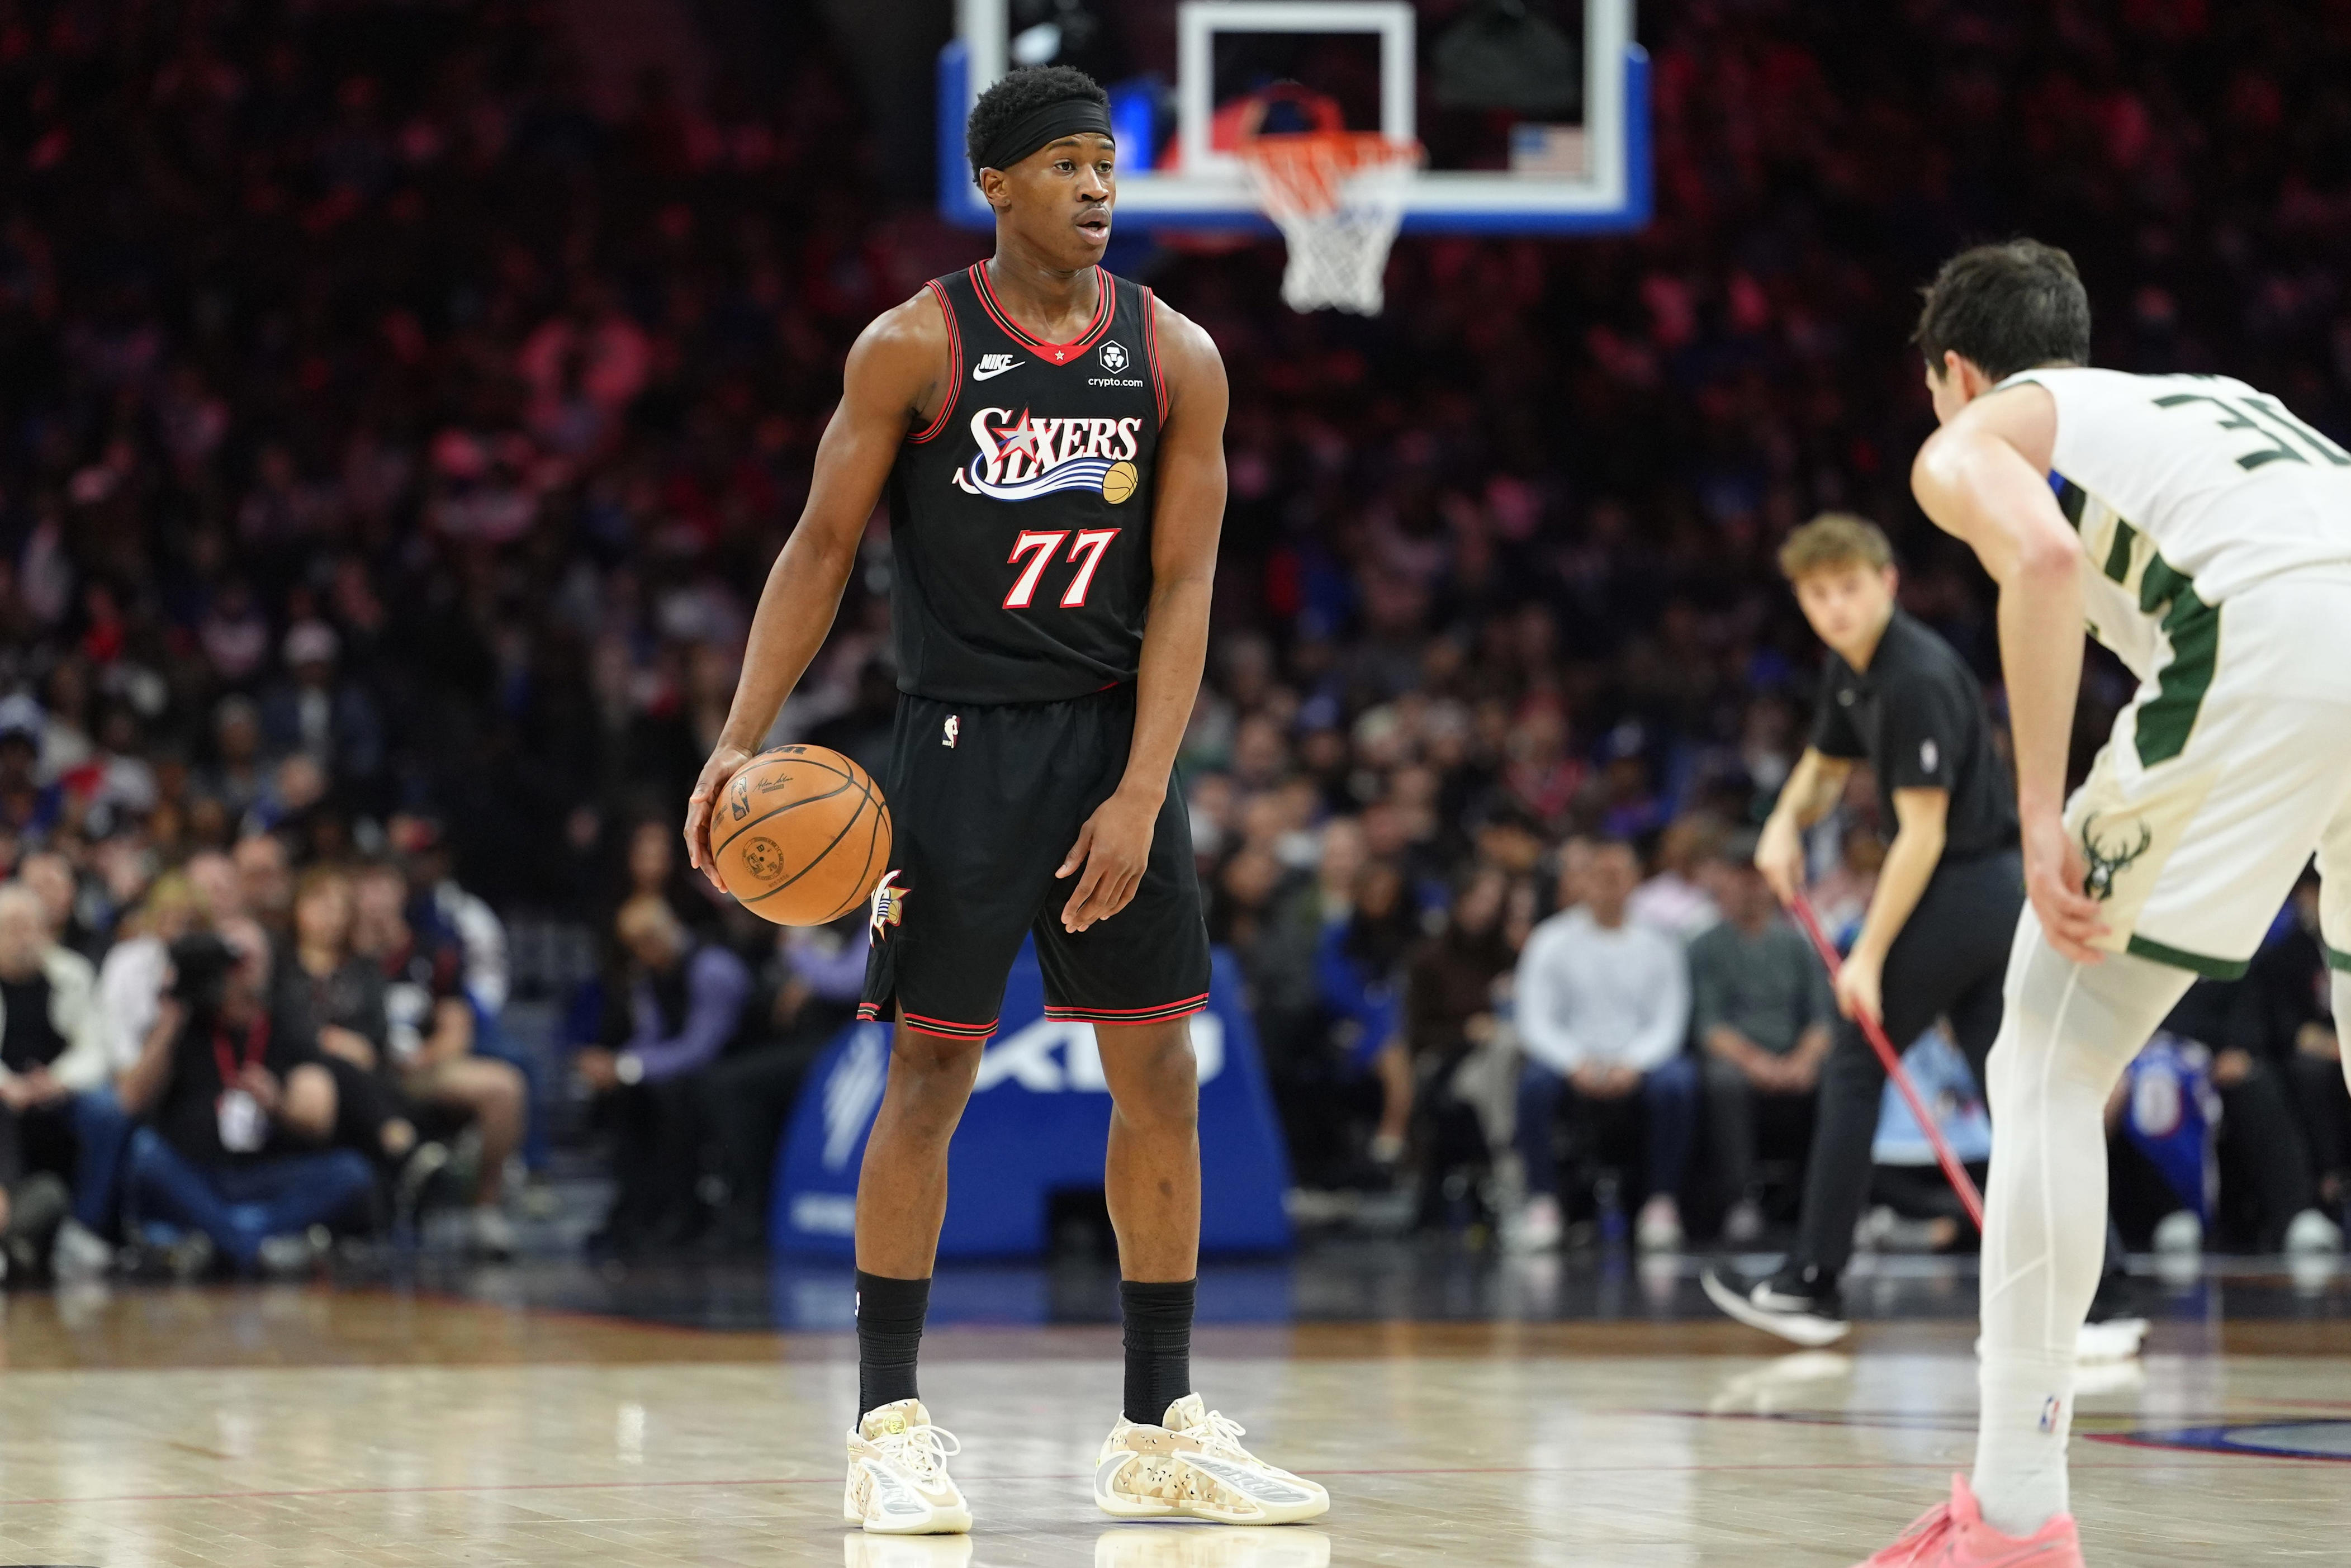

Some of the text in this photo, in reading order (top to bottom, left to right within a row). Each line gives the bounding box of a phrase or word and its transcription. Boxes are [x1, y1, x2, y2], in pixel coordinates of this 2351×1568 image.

[979, 354, 1013, 370] NIKE
[1088, 377, 1143, 387] crypto.com
[951, 406, 1142, 494] SIXERS
[1002, 528, 1122, 609] 77
